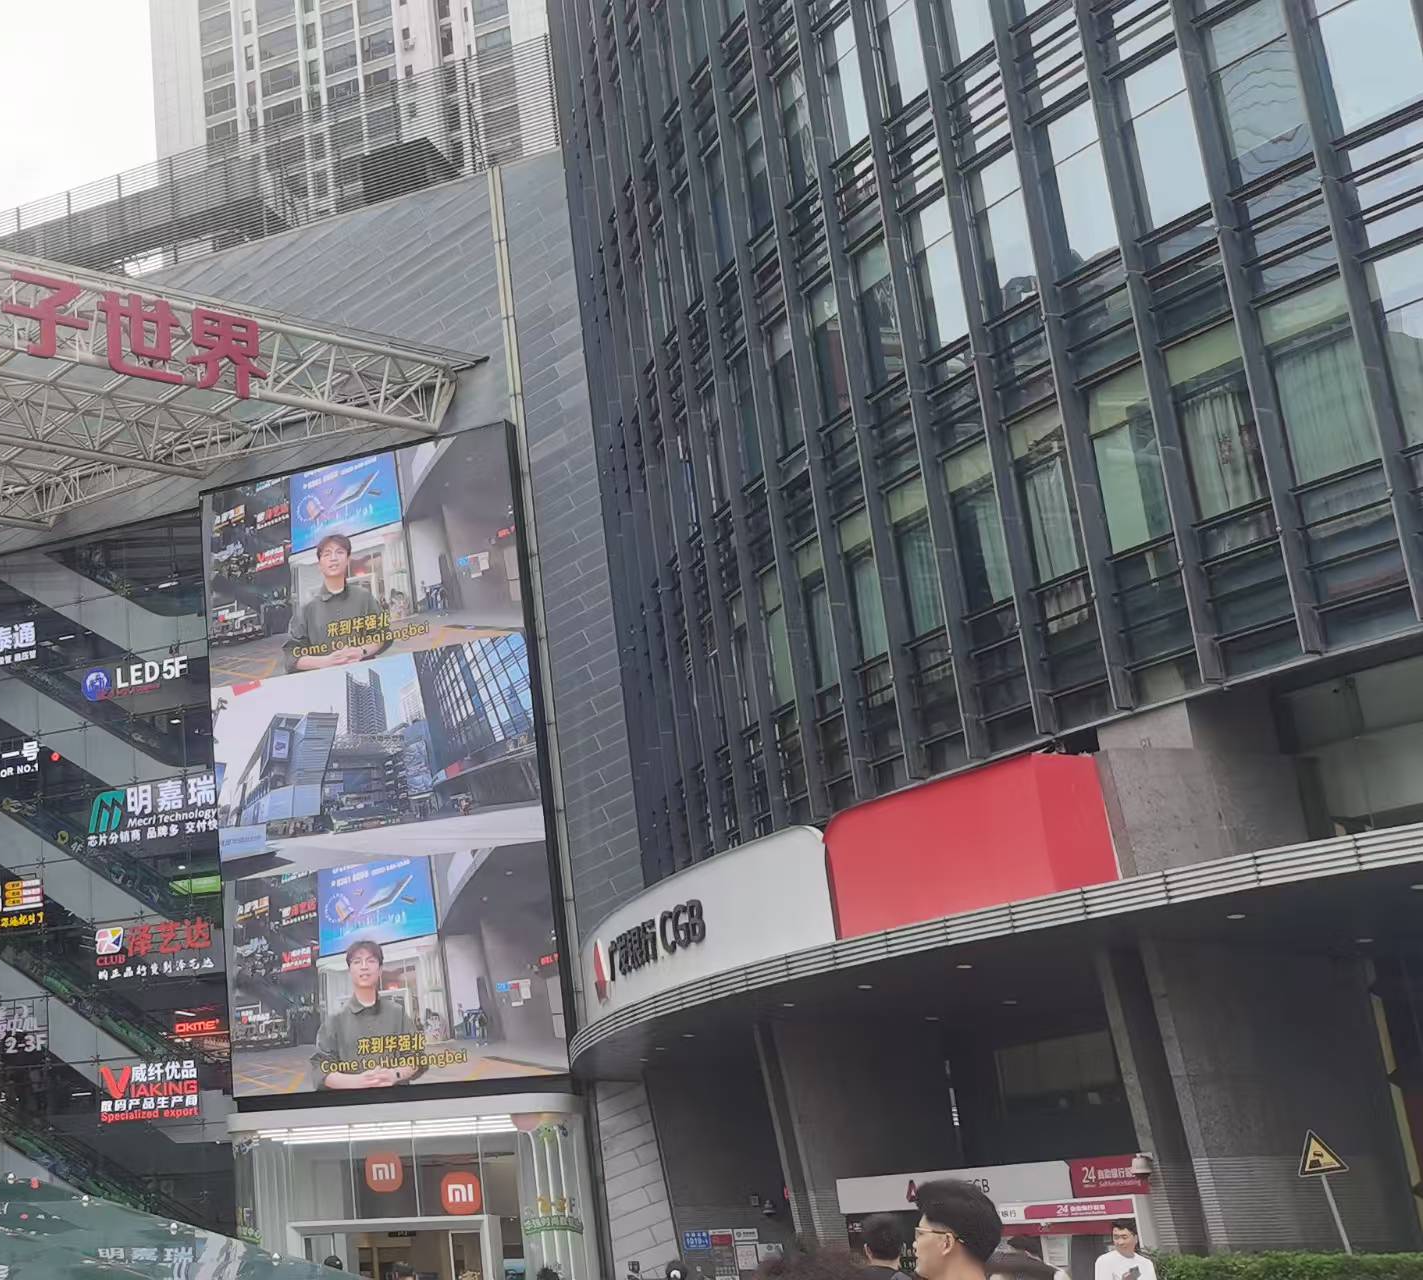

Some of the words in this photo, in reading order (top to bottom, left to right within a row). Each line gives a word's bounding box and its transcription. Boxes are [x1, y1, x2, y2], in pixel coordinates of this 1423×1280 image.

[327, 612, 391, 638] 来到华强北
[292, 643, 328, 658] Come
[331, 640, 344, 651] to
[348, 622, 430, 648] Huaqiangbei
[126, 774, 216, 816] 明嘉瑞
[159, 807, 218, 824] Technology
[184, 817, 218, 835] 交付快
[127, 916, 212, 957] 泽艺达
[659, 899, 706, 956] CGB
[96, 955, 126, 967] CLUB
[4, 1034, 48, 1055] 2-3F
[357, 1032, 425, 1055] 来到华强北
[132, 1060, 198, 1082] 威纤优品
[320, 1059, 358, 1073] Come
[362, 1058, 376, 1070] to
[380, 1049, 468, 1070] Huaqiangbei
[100, 1110, 160, 1124] Specialized
[163, 1107, 199, 1118] export
[1082, 1166, 1097, 1184] 24
